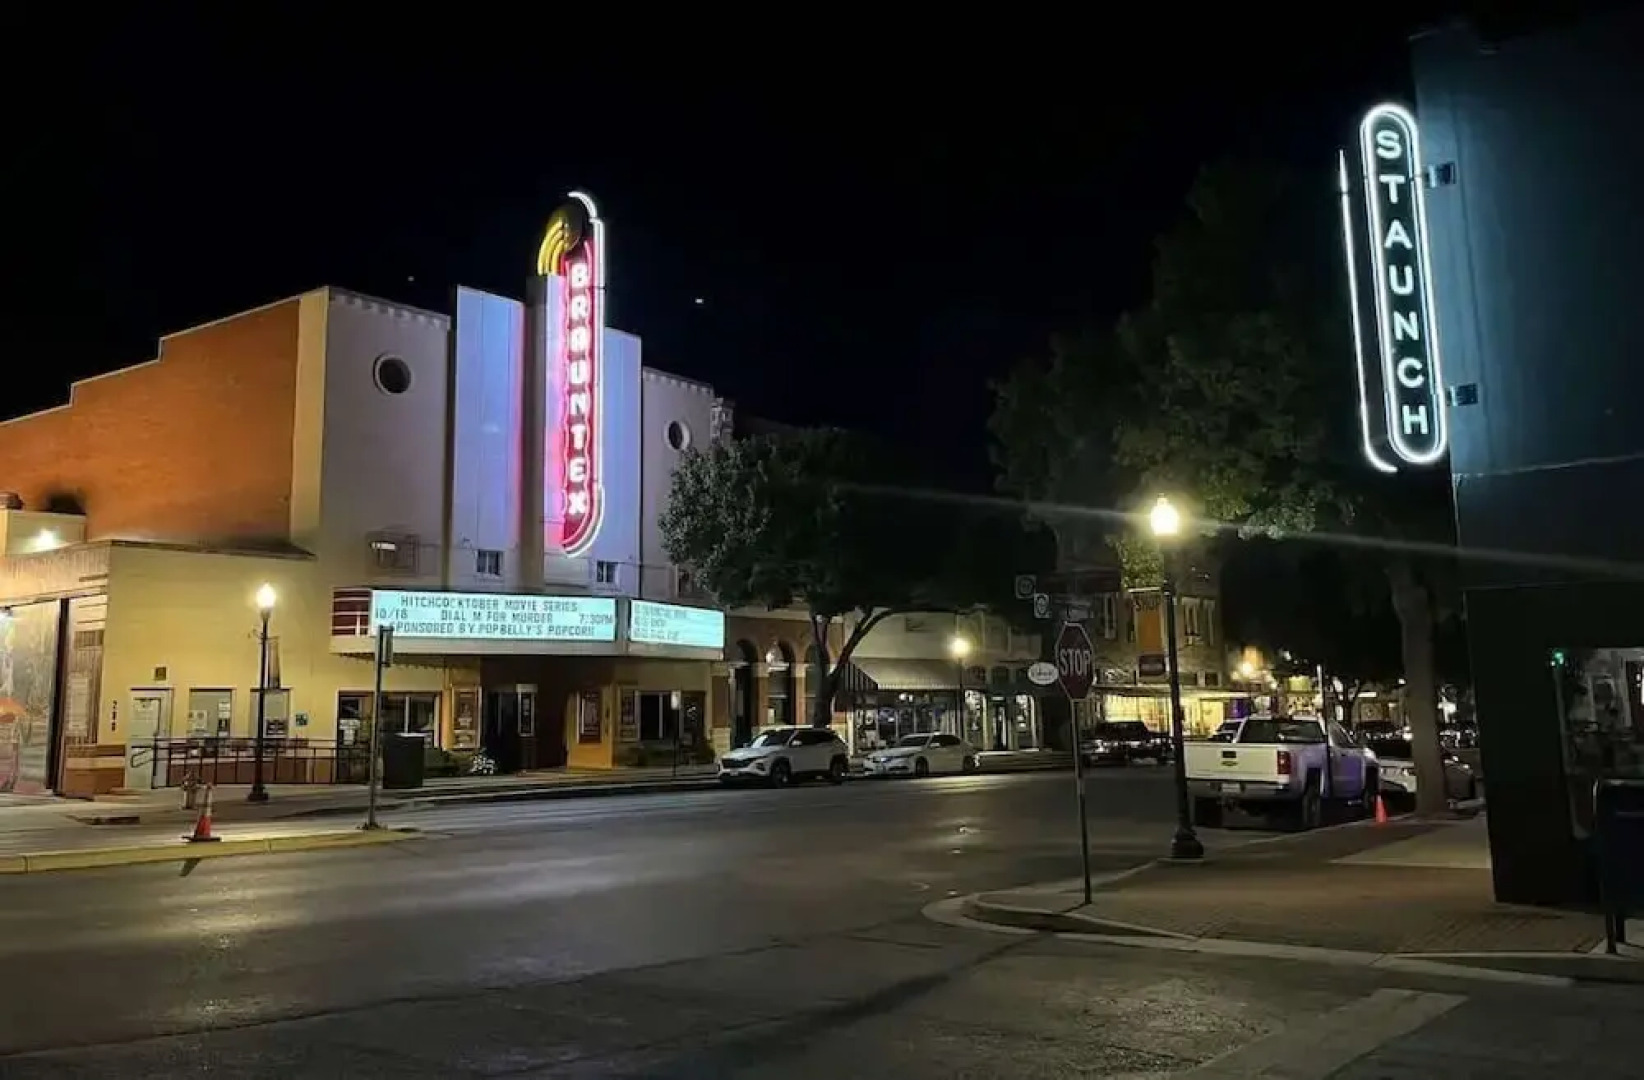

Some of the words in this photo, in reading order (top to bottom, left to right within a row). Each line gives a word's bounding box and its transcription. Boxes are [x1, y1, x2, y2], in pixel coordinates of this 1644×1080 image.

[1375, 129, 1429, 435] STAUNCH
[569, 263, 590, 515] BRAUNTEX
[400, 595, 498, 610] HITCHCOCKTOBER
[504, 598, 536, 611] MOVIE
[543, 599, 578, 612] SERIES
[441, 609, 466, 621] DIAL
[473, 610, 481, 621] M
[486, 610, 507, 622] FOR
[512, 611, 553, 624] MURDER
[579, 612, 613, 624] 7:30PM
[458, 622, 475, 634] BY
[478, 622, 542, 635] POPBELLY'S
[1059, 648, 1091, 676] STOP
